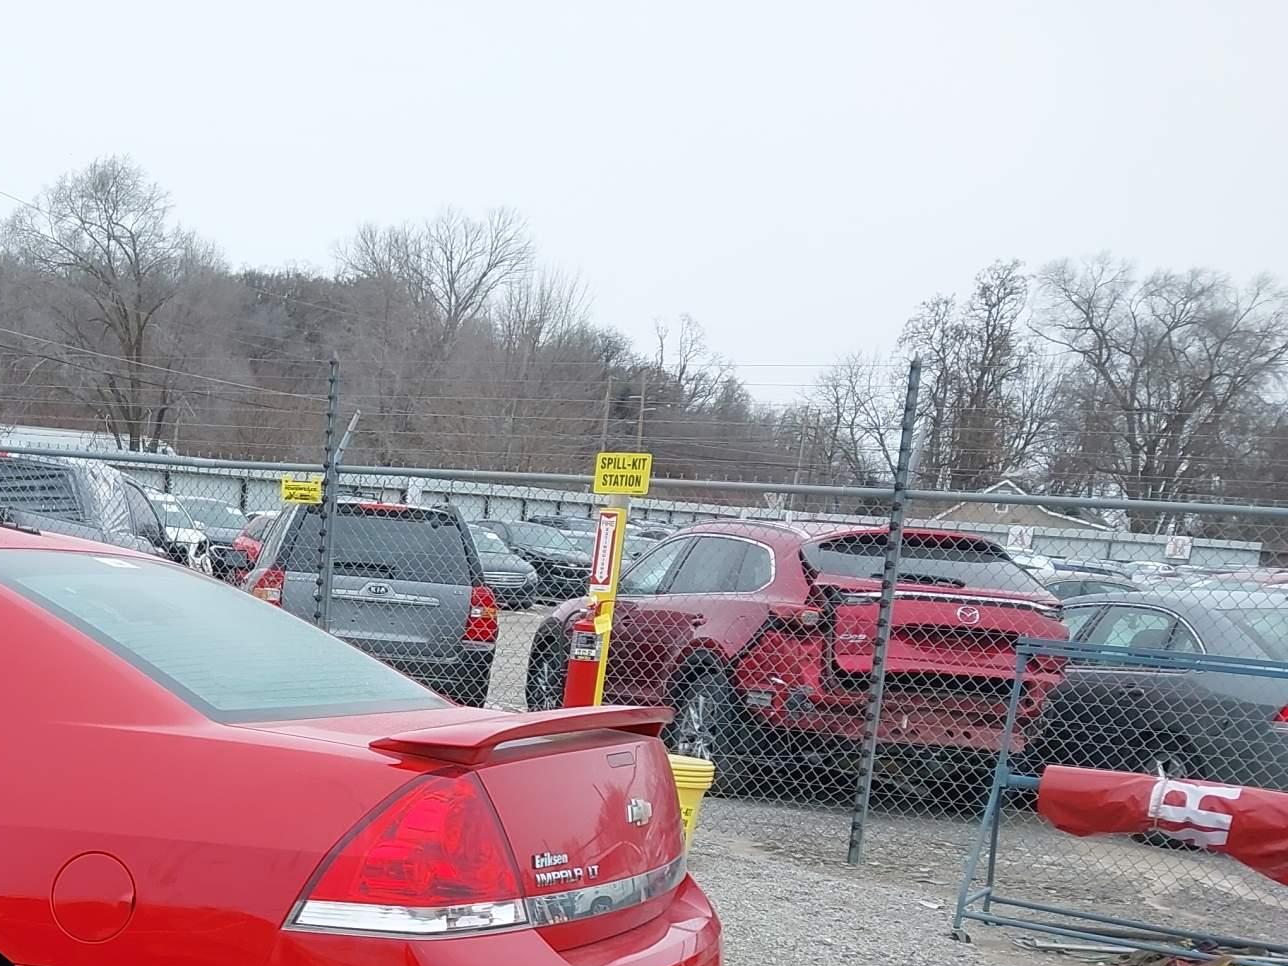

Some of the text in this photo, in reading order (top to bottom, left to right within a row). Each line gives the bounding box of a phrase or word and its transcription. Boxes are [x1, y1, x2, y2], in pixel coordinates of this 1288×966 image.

[600, 457, 648, 470] SPILL-KIT
[602, 474, 642, 487] STATION
[534, 852, 569, 869] Eriksen
